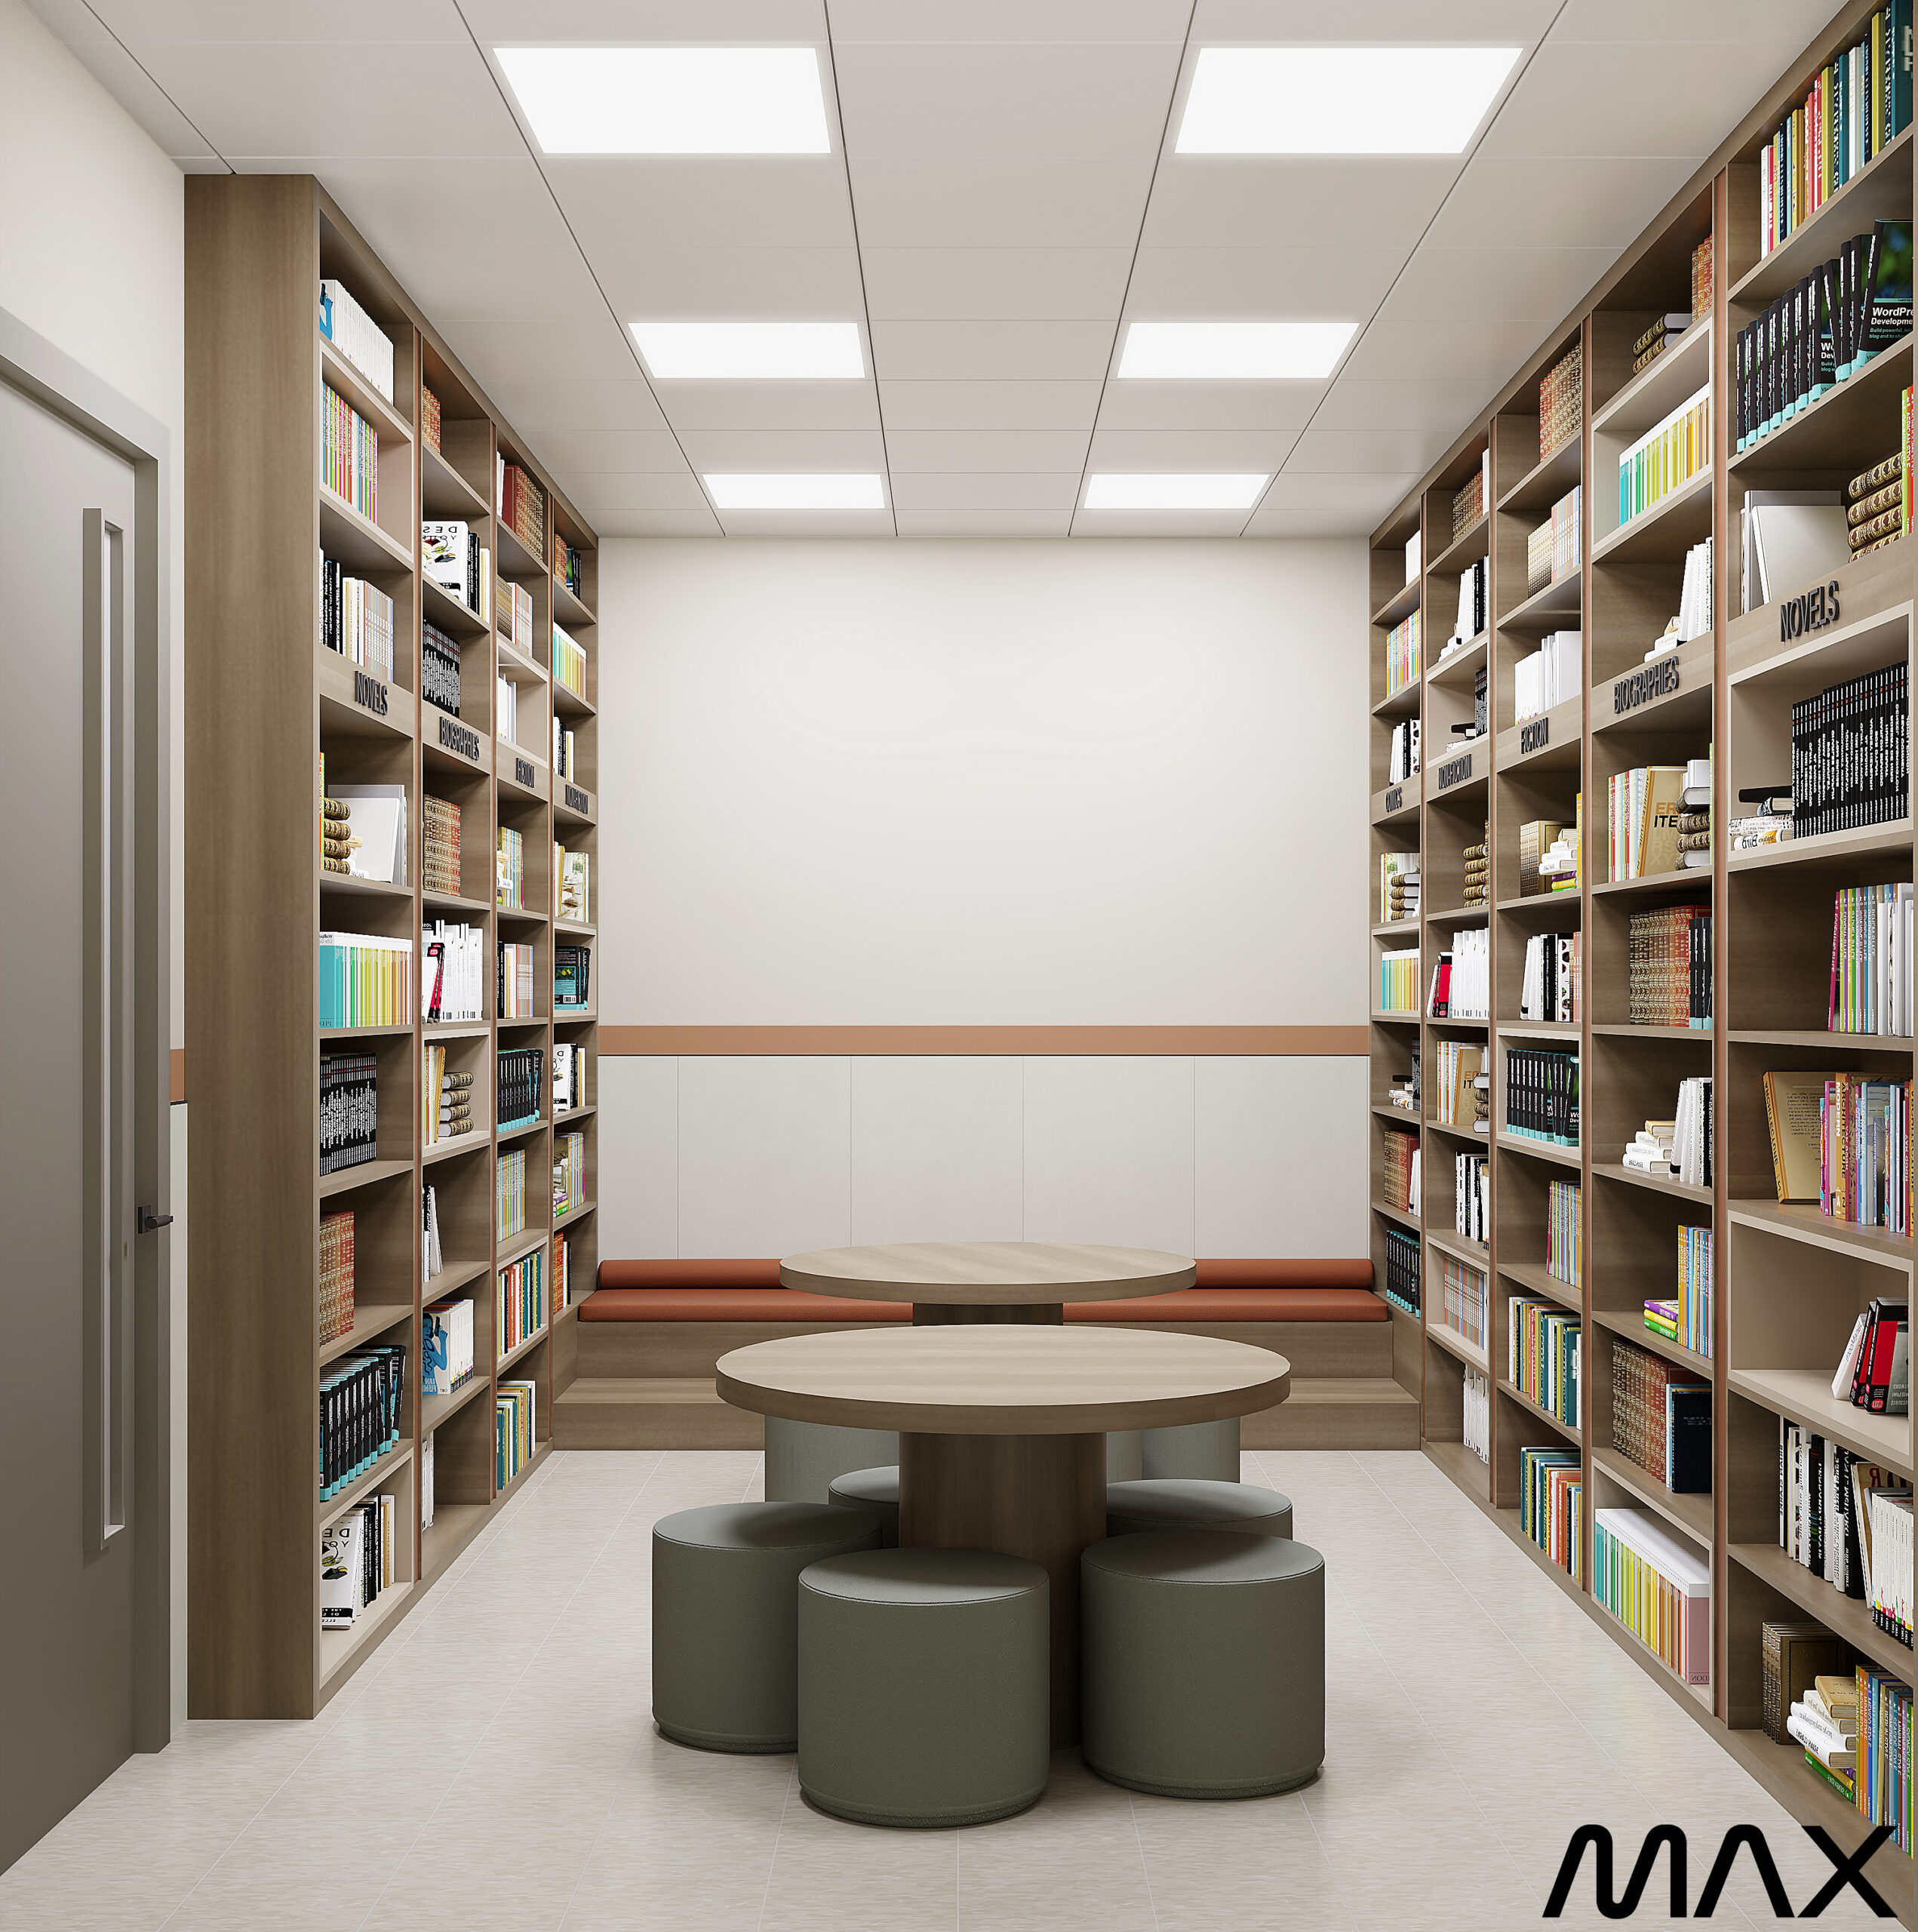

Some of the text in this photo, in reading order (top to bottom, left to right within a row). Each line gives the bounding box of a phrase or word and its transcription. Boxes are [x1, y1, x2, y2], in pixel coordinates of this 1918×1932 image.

[1871, 317, 1913, 325] Developme
[1780, 580, 1840, 642] NOVELS
[355, 671, 388, 715] NOVELS
[1613, 656, 1679, 714] BIOGRAPHIES
[439, 716, 479, 761] BIOGRAPHIES
[1521, 718, 1548, 754] FICTION
[1654, 815, 1677, 828] ITE
